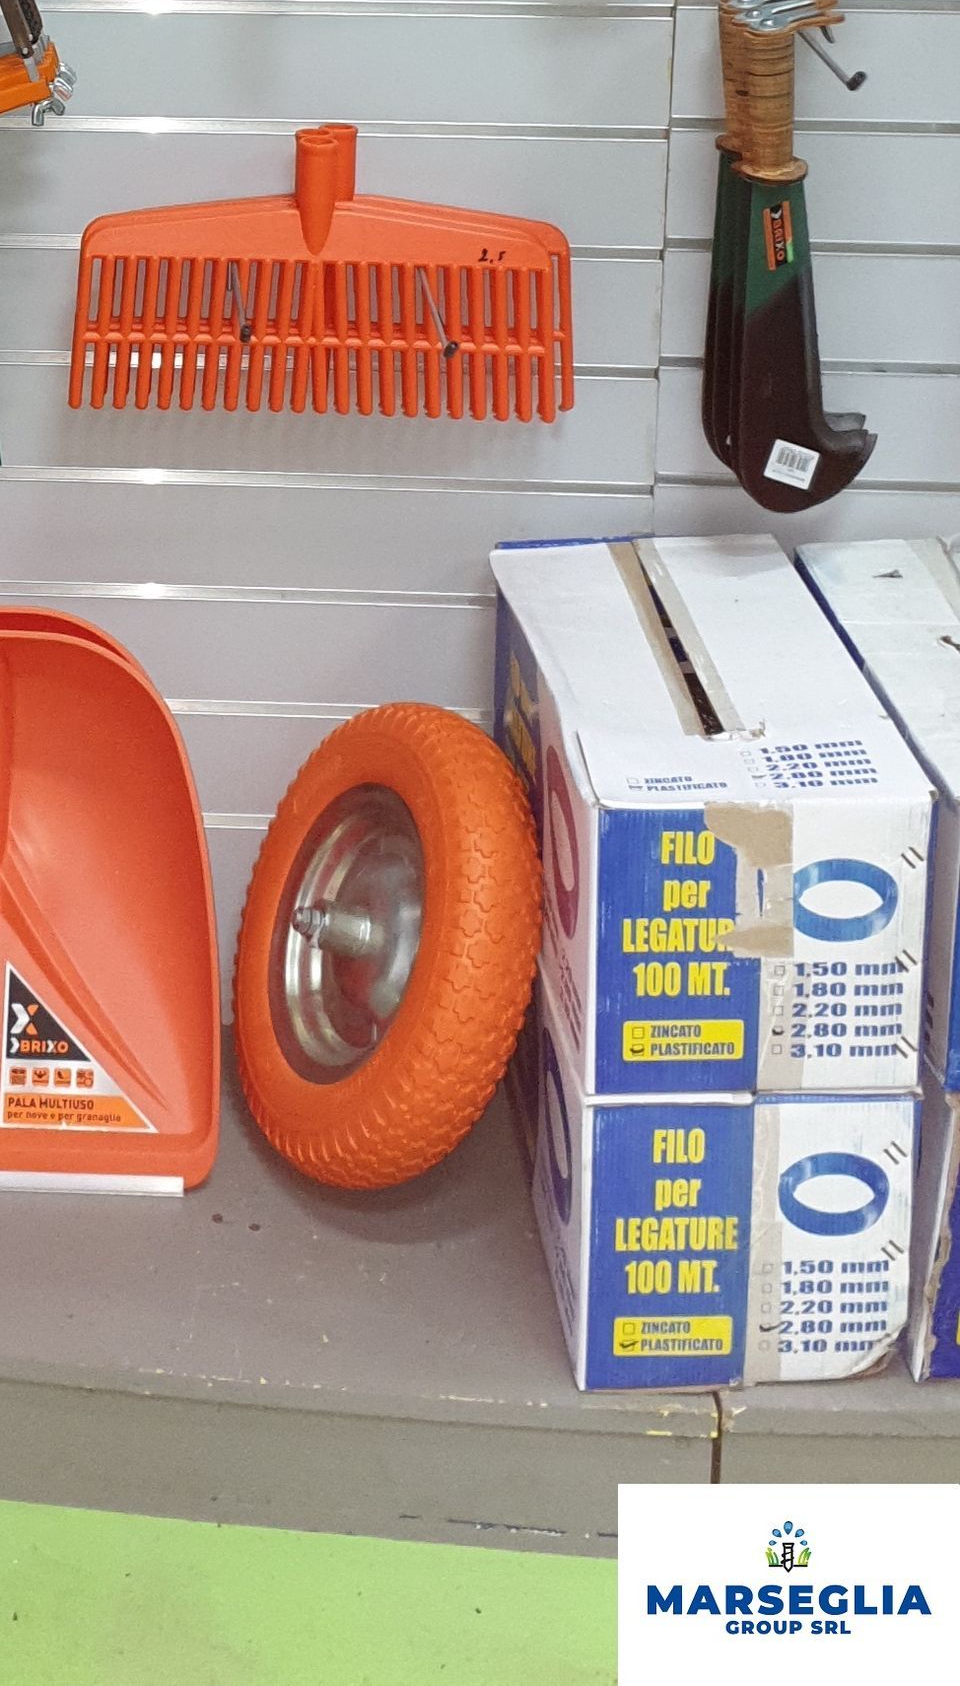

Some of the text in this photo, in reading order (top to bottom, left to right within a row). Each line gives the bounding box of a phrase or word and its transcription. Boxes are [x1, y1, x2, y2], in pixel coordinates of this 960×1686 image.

[772, 219, 786, 261] BRIXO
[660, 830, 716, 865] FILO
[663, 879, 711, 912] per
[622, 917, 736, 953] LEGATUR
[855, 962, 904, 976] mm
[632, 961, 731, 997] 100 MT.
[854, 983, 903, 996] mm
[854, 1004, 902, 1017] mm
[649, 1025, 702, 1039] ZINCATO
[854, 1023, 902, 1037] mm
[20, 1040, 69, 1054] BRIXO
[650, 1042, 735, 1056] PLASTIFICATO
[849, 1044, 897, 1057] mm
[8, 1097, 95, 1111] PALA MULTIUSO
[7, 1111, 23, 1120] per
[58, 1111, 74, 1121] per
[652, 1128, 706, 1164] FILO
[654, 1178, 702, 1212] per
[614, 1216, 739, 1252] LEGATURE
[841, 1260, 889, 1274] mm
[624, 1260, 721, 1294] 100 MT.
[840, 1281, 889, 1293] mm
[840, 1301, 888, 1314] mm
[640, 1321, 691, 1335] ZINCATO
[840, 1320, 887, 1333] mm
[640, 1338, 724, 1352] PLASTIFICATO
